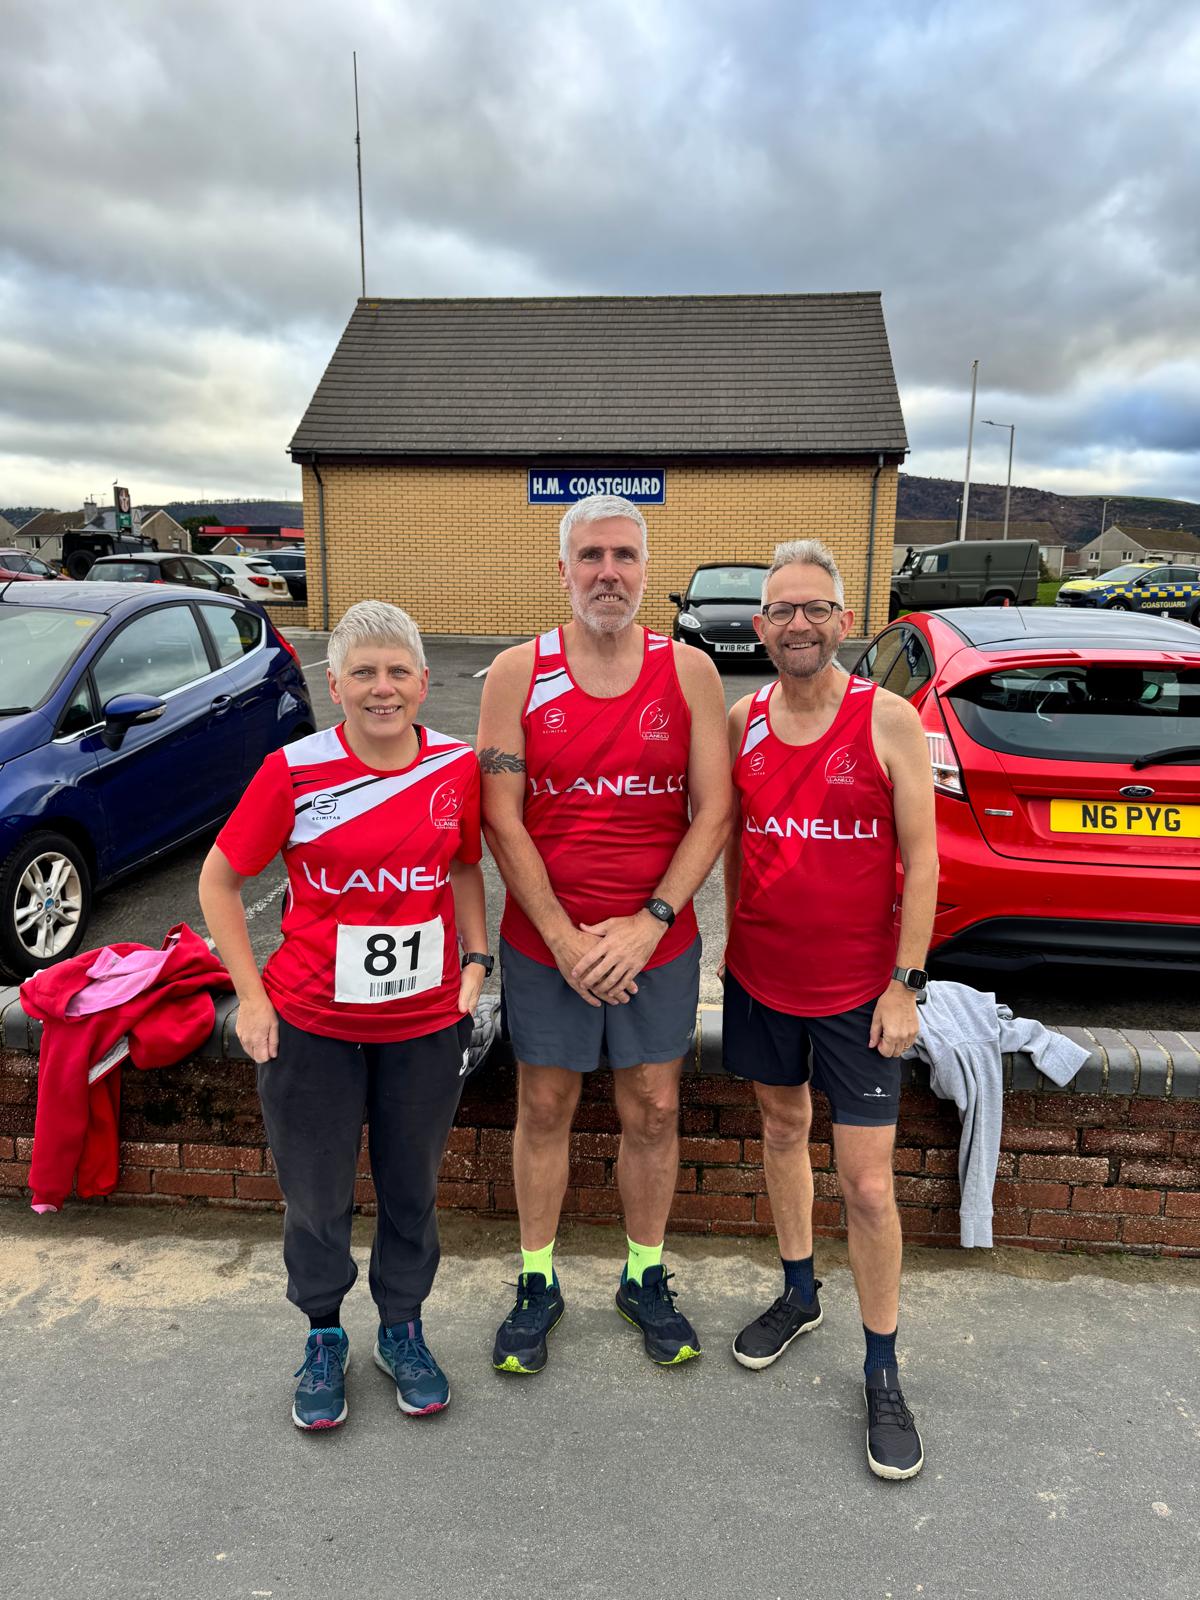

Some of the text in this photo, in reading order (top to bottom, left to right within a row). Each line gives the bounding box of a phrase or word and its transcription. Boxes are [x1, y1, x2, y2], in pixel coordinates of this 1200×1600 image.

[532, 477, 661, 496] H.M. COASTGUARD
[1141, 601, 1187, 609] COASTGUARD
[530, 775, 685, 796] LLANELLI
[746, 814, 878, 840] LLANELLI
[1082, 804, 1181, 832] N6 PYG
[302, 861, 450, 895] LLANEL
[363, 930, 421, 977] 81
